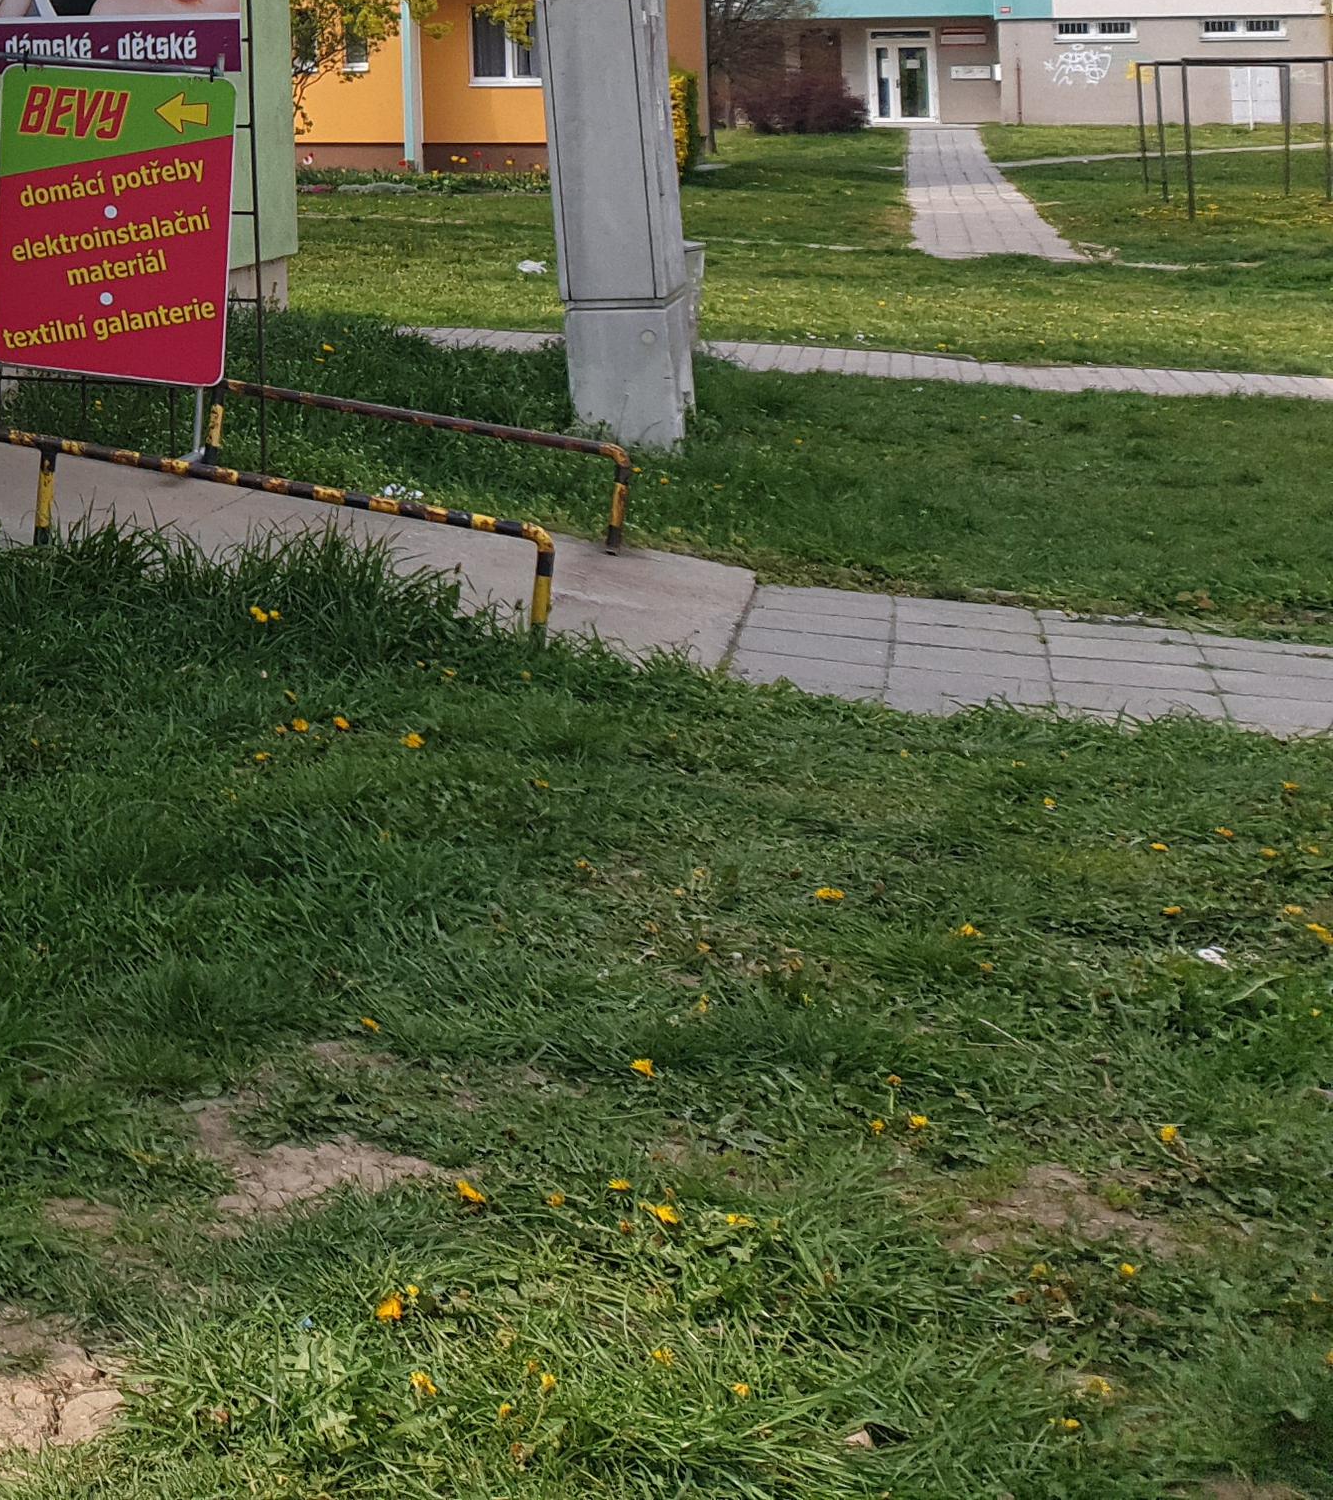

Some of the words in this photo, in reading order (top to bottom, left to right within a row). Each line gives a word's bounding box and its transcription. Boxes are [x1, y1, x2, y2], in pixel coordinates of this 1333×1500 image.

[117, 29, 197, 60] dětské
[18, 84, 131, 141] BEVY
[19, 170, 106, 207] domácí
[111, 157, 205, 197] potřeby
[11, 206, 211, 263] elektroinstalační
[66, 250, 168, 286] materiál
[3, 315, 87, 350] textilní
[92, 298, 216, 341] galanterie
